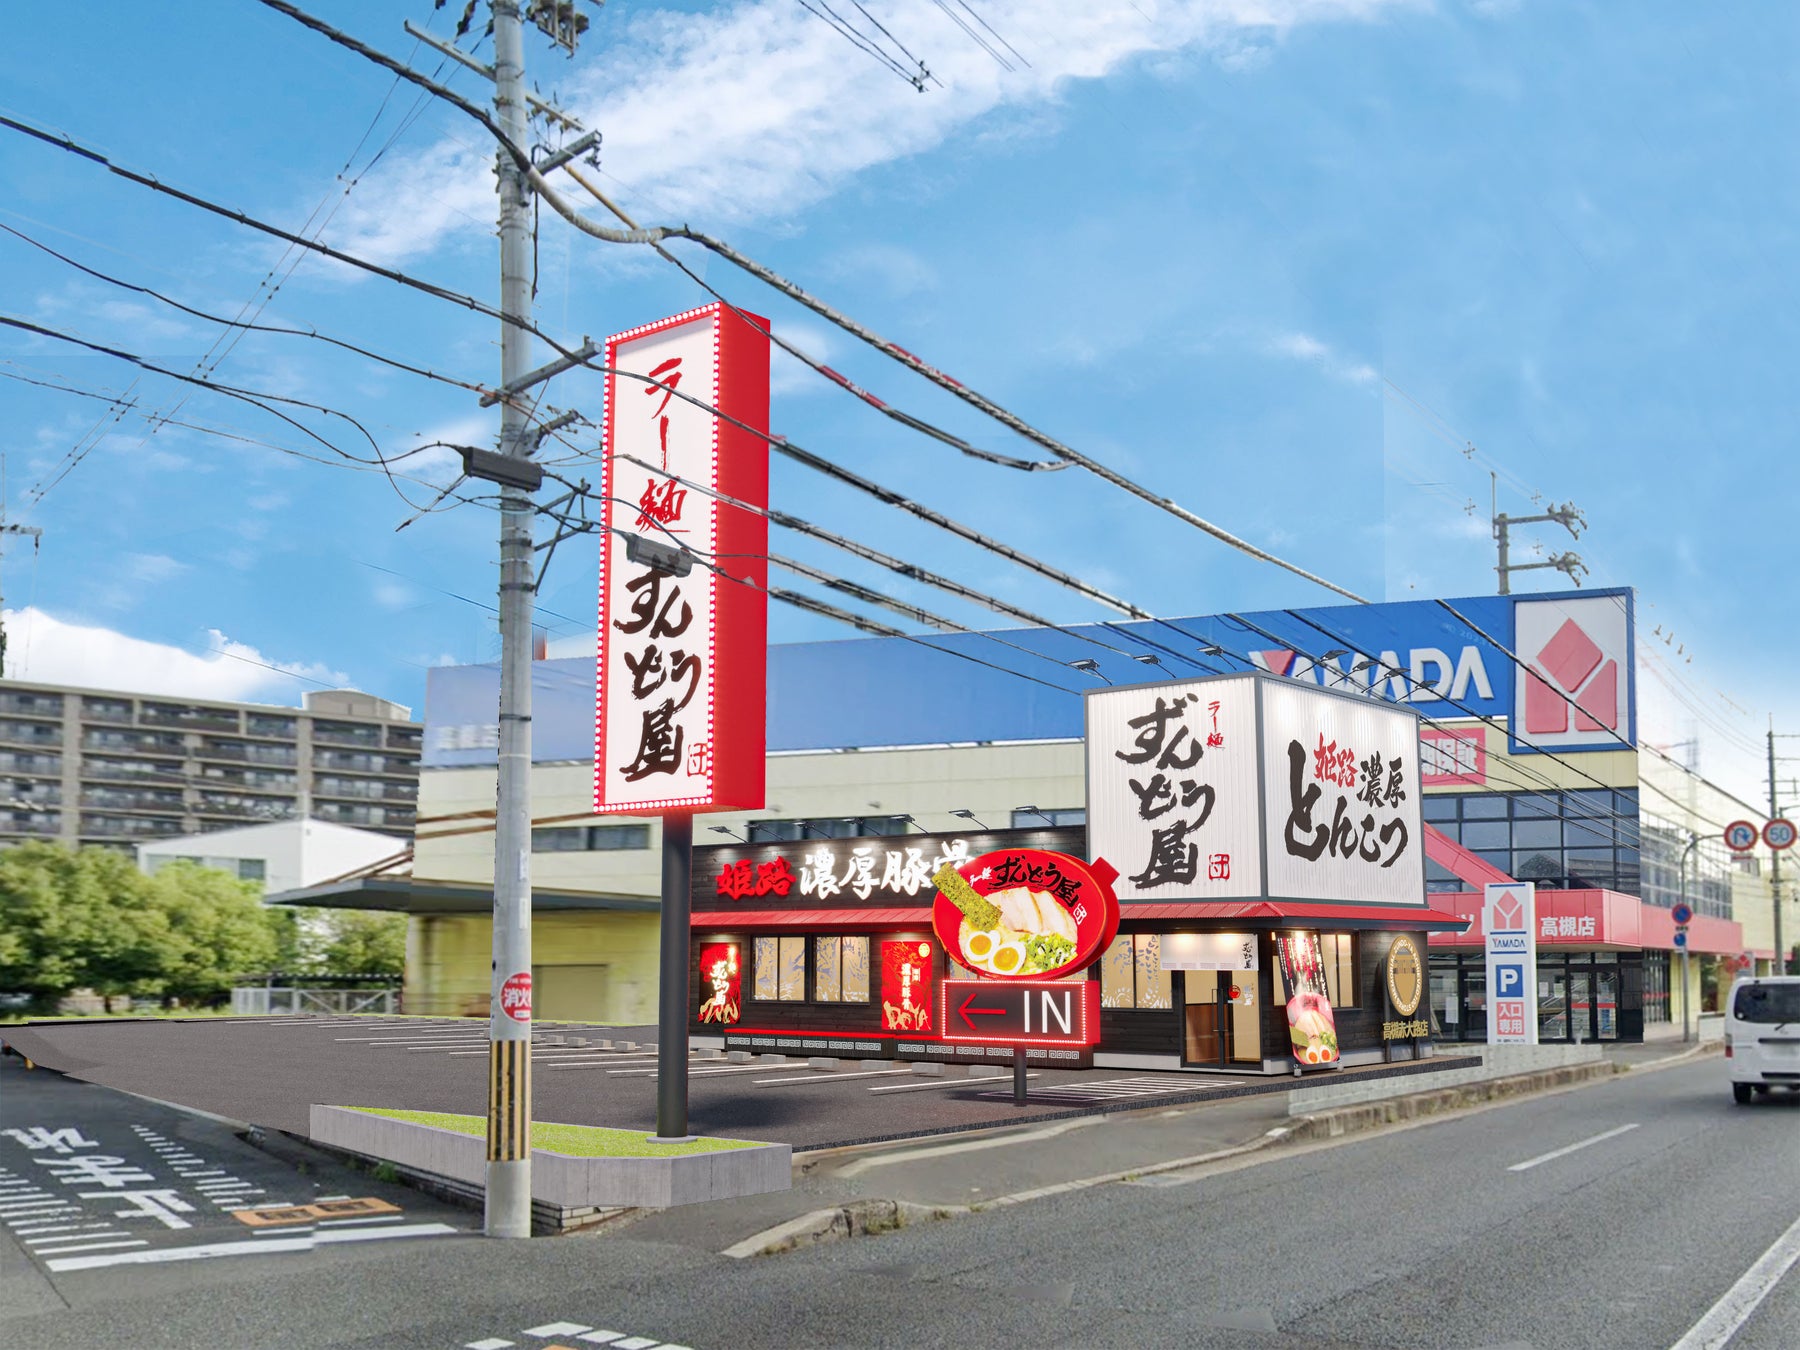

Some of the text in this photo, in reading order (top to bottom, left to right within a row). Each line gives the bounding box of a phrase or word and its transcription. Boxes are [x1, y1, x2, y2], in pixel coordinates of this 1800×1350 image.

[1206, 700, 1226, 749] ラー麺
[1313, 731, 1407, 809] 姫路 濃厚
[1116, 692, 1215, 889] ずんどう屋
[1284, 739, 1409, 868] とんこつ
[1769, 826, 1790, 842] 50
[716, 855, 796, 900] 姫路
[1540, 916, 1596, 937] 高槻店
[1492, 938, 1526, 949] YAMADA
[1500, 968, 1519, 992] P
[504, 987, 531, 1008] 消火
[1024, 990, 1071, 1034] IN
[1499, 1004, 1522, 1017] 入口
[1499, 1018, 1523, 1033] 専用
